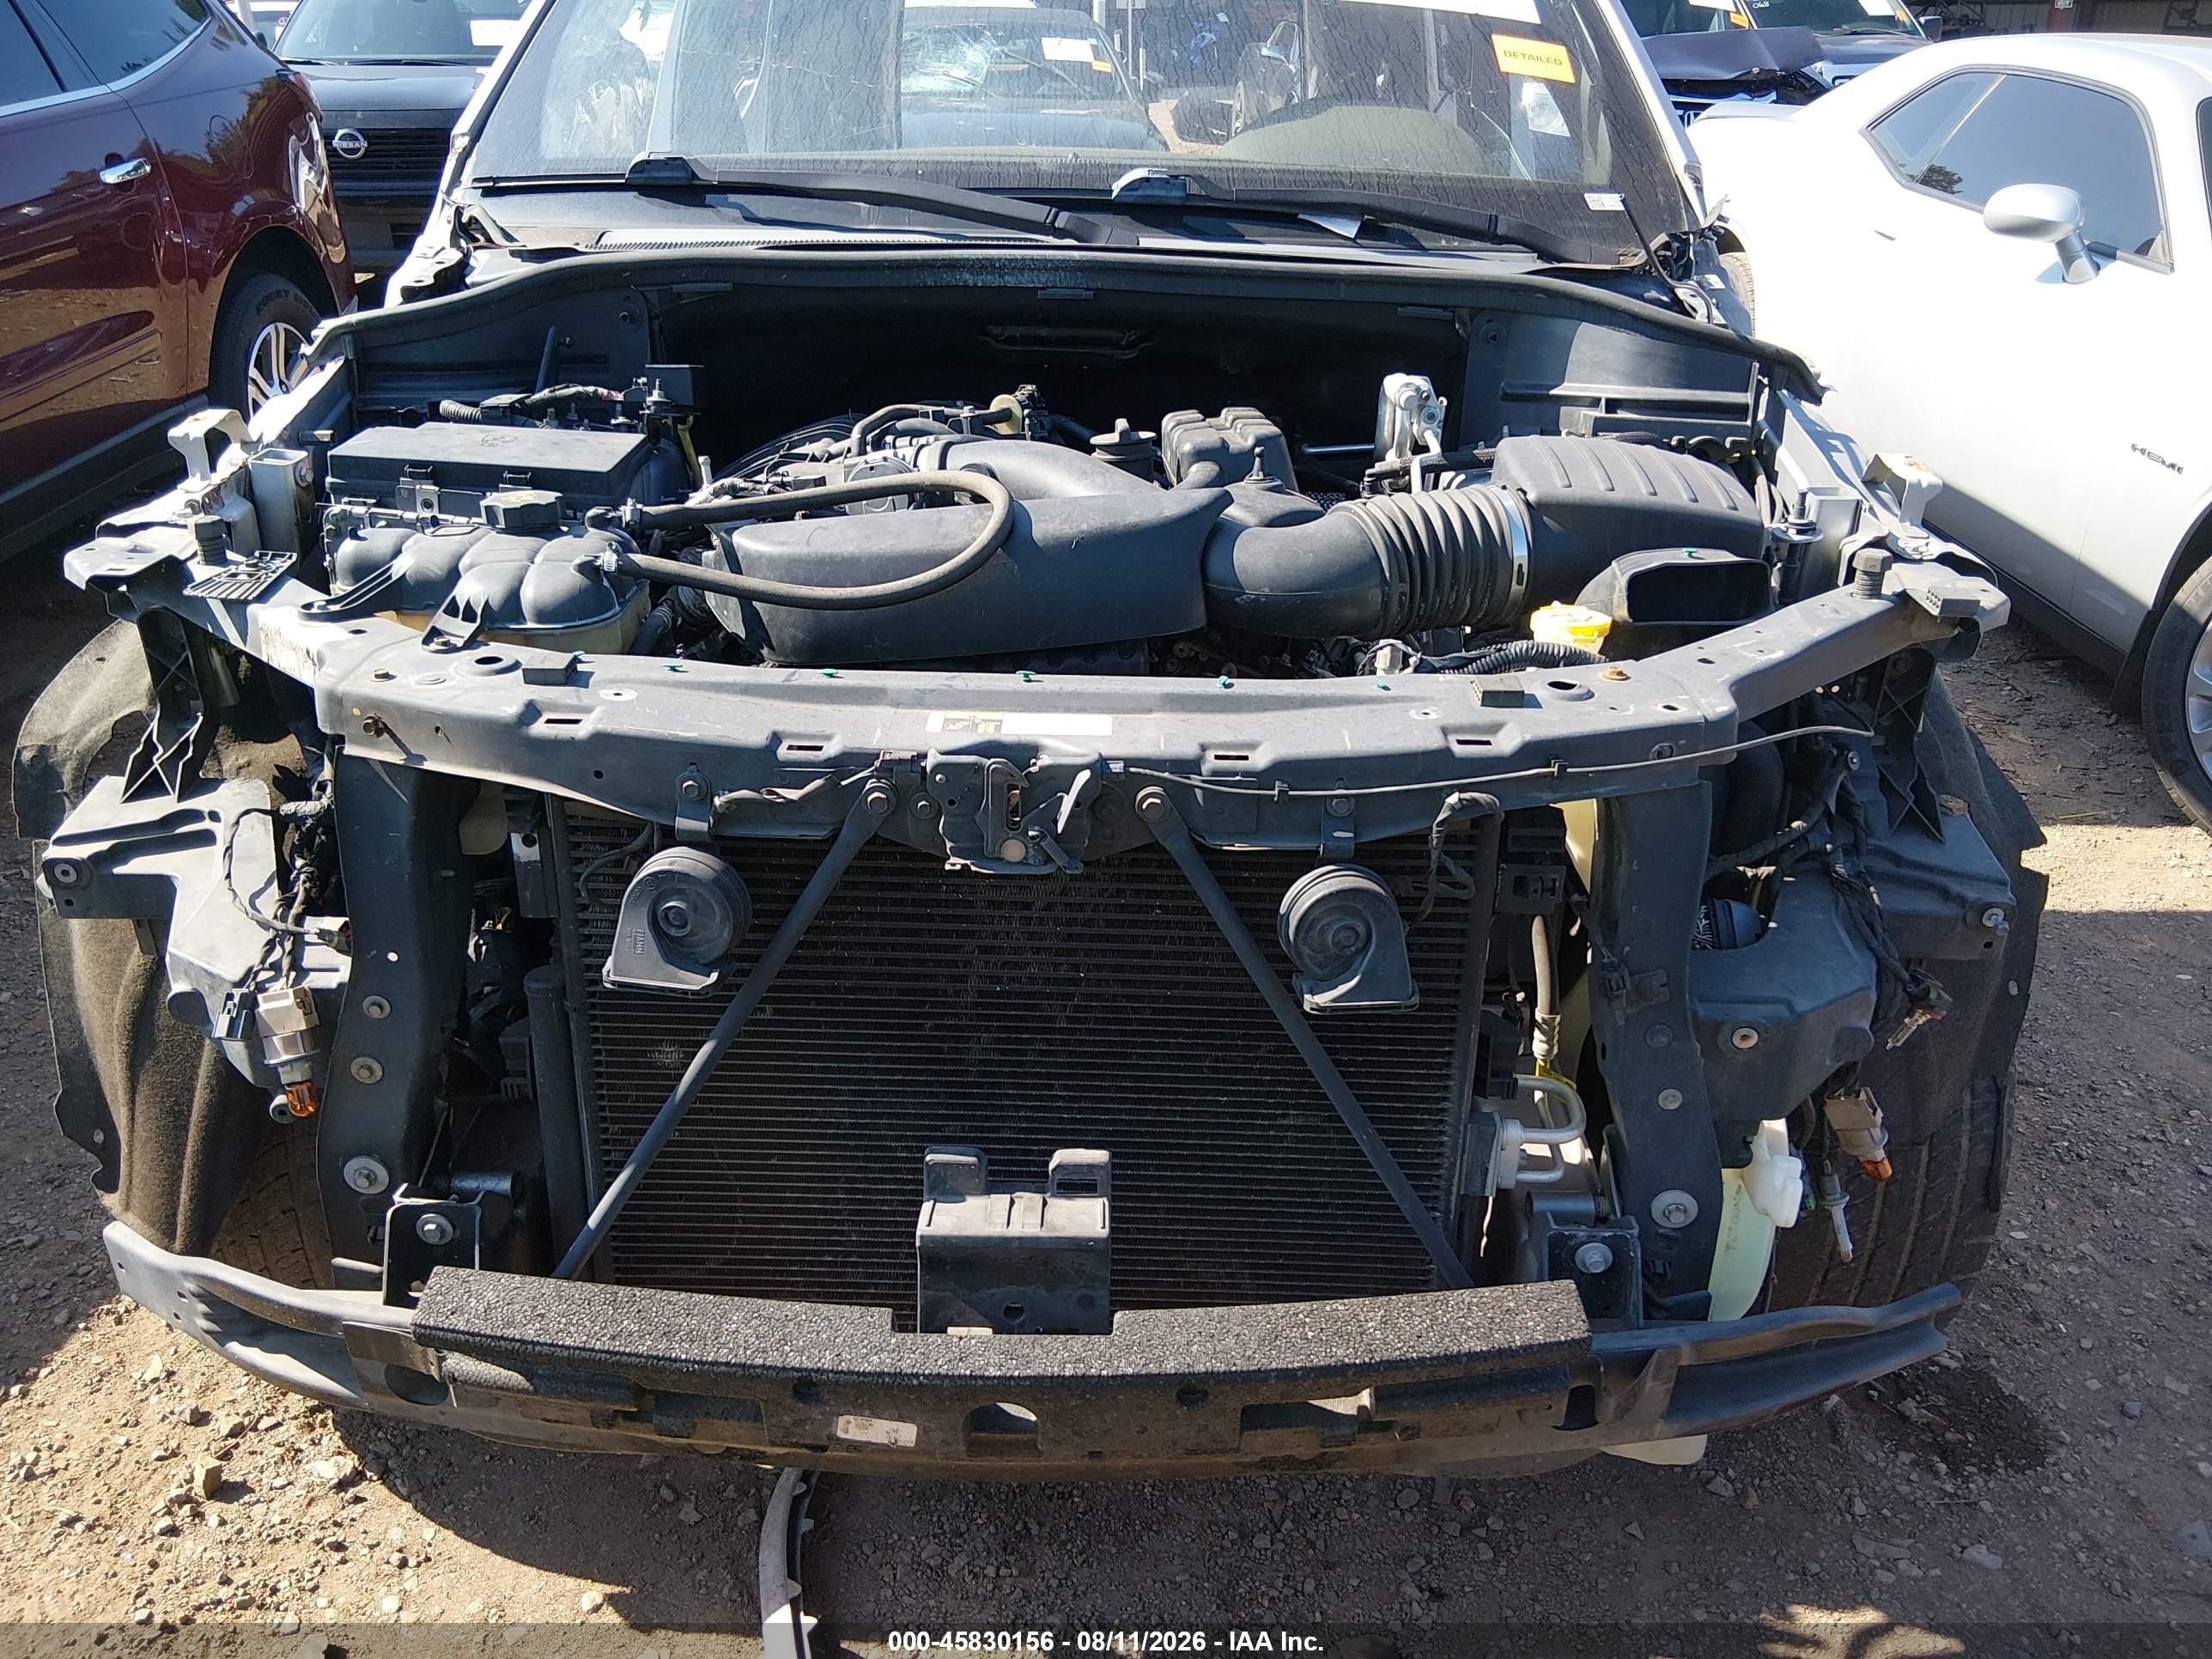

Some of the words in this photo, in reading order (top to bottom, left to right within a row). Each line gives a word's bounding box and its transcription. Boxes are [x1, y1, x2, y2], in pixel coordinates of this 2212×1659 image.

[1504, 50, 1563, 65] DETAILED
[332, 140, 368, 149] NISSAN
[2130, 442, 2184, 475] HEMI
